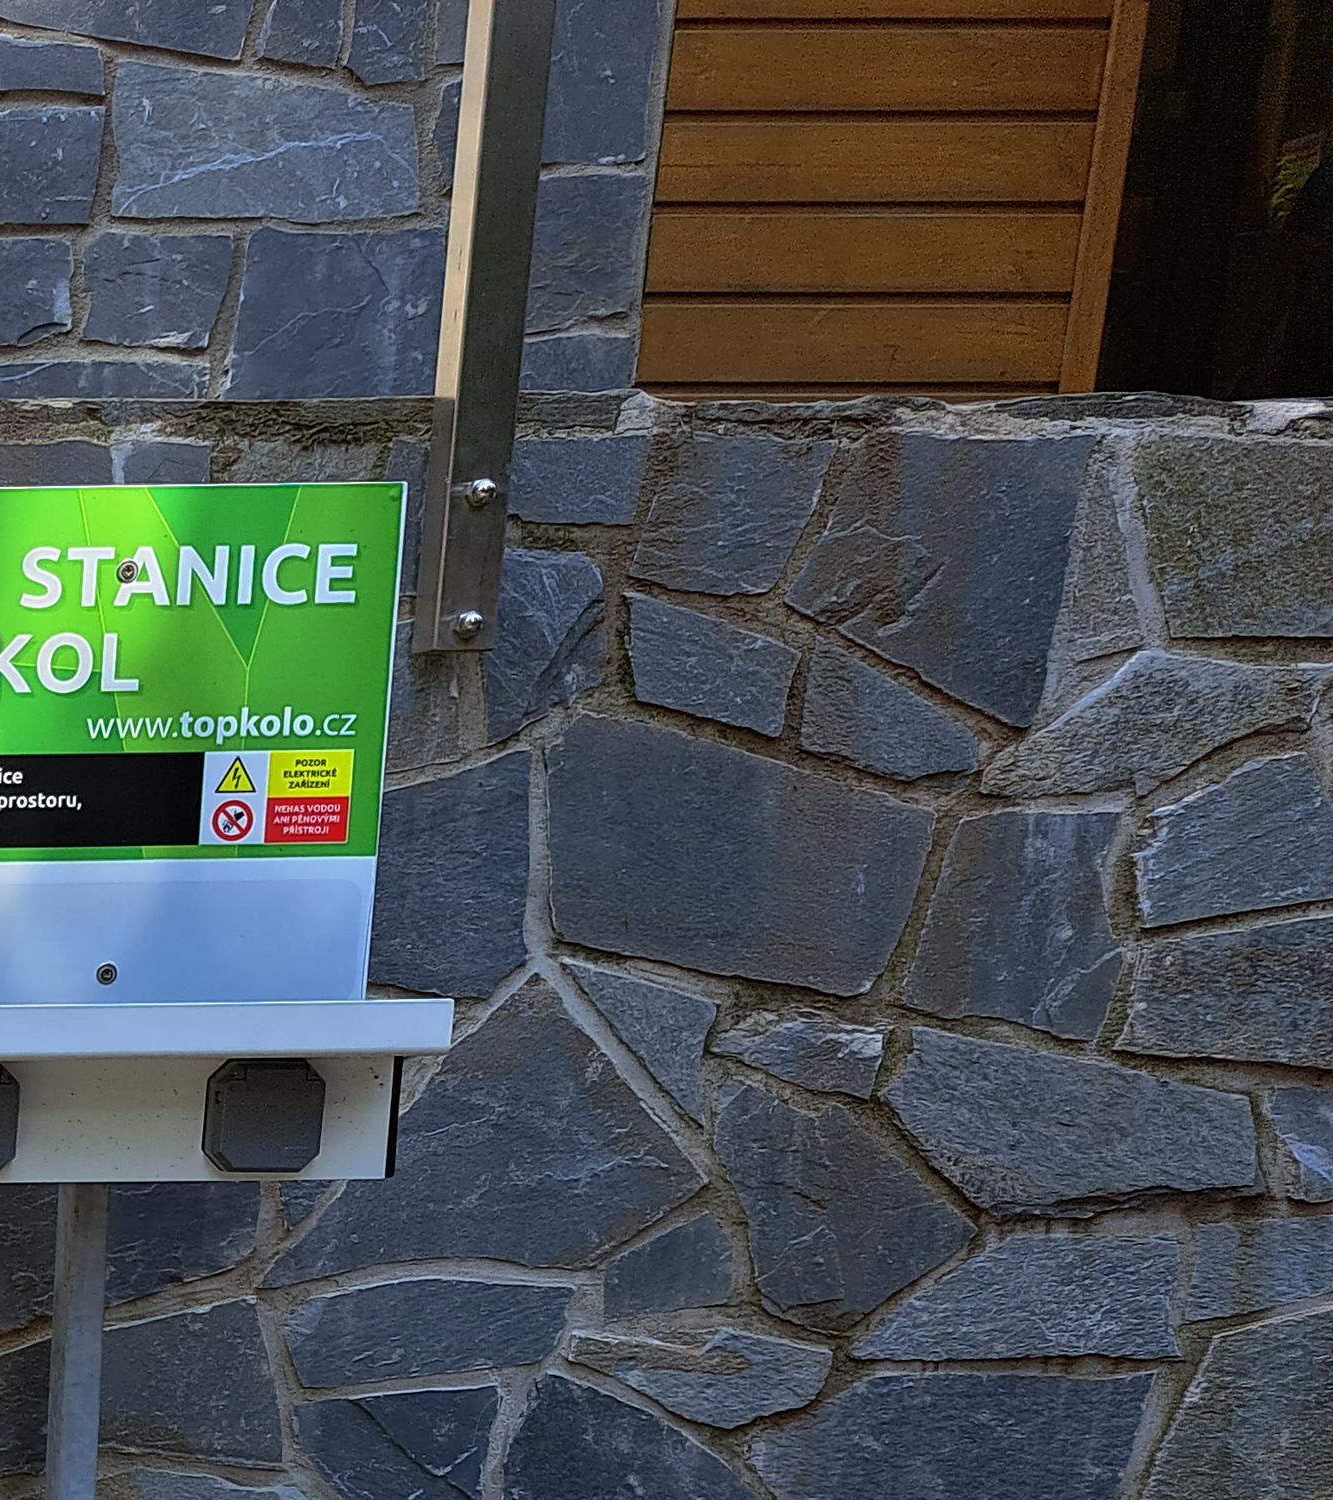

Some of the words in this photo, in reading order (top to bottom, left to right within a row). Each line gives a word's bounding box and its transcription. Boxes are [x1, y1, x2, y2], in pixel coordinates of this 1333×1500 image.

[19, 543, 359, 607] STANICE
[87, 706, 357, 744] www.topkolo.cz
[295, 759, 326, 767] POZOR
[283, 768, 337, 778] ELEKTRICKÉ
[288, 779, 330, 789] ZAŘÍZENÍ
[307, 803, 341, 813] VODOU
[273, 815, 289, 824] ANI
[283, 824, 329, 835] PŘÍSTROJI
